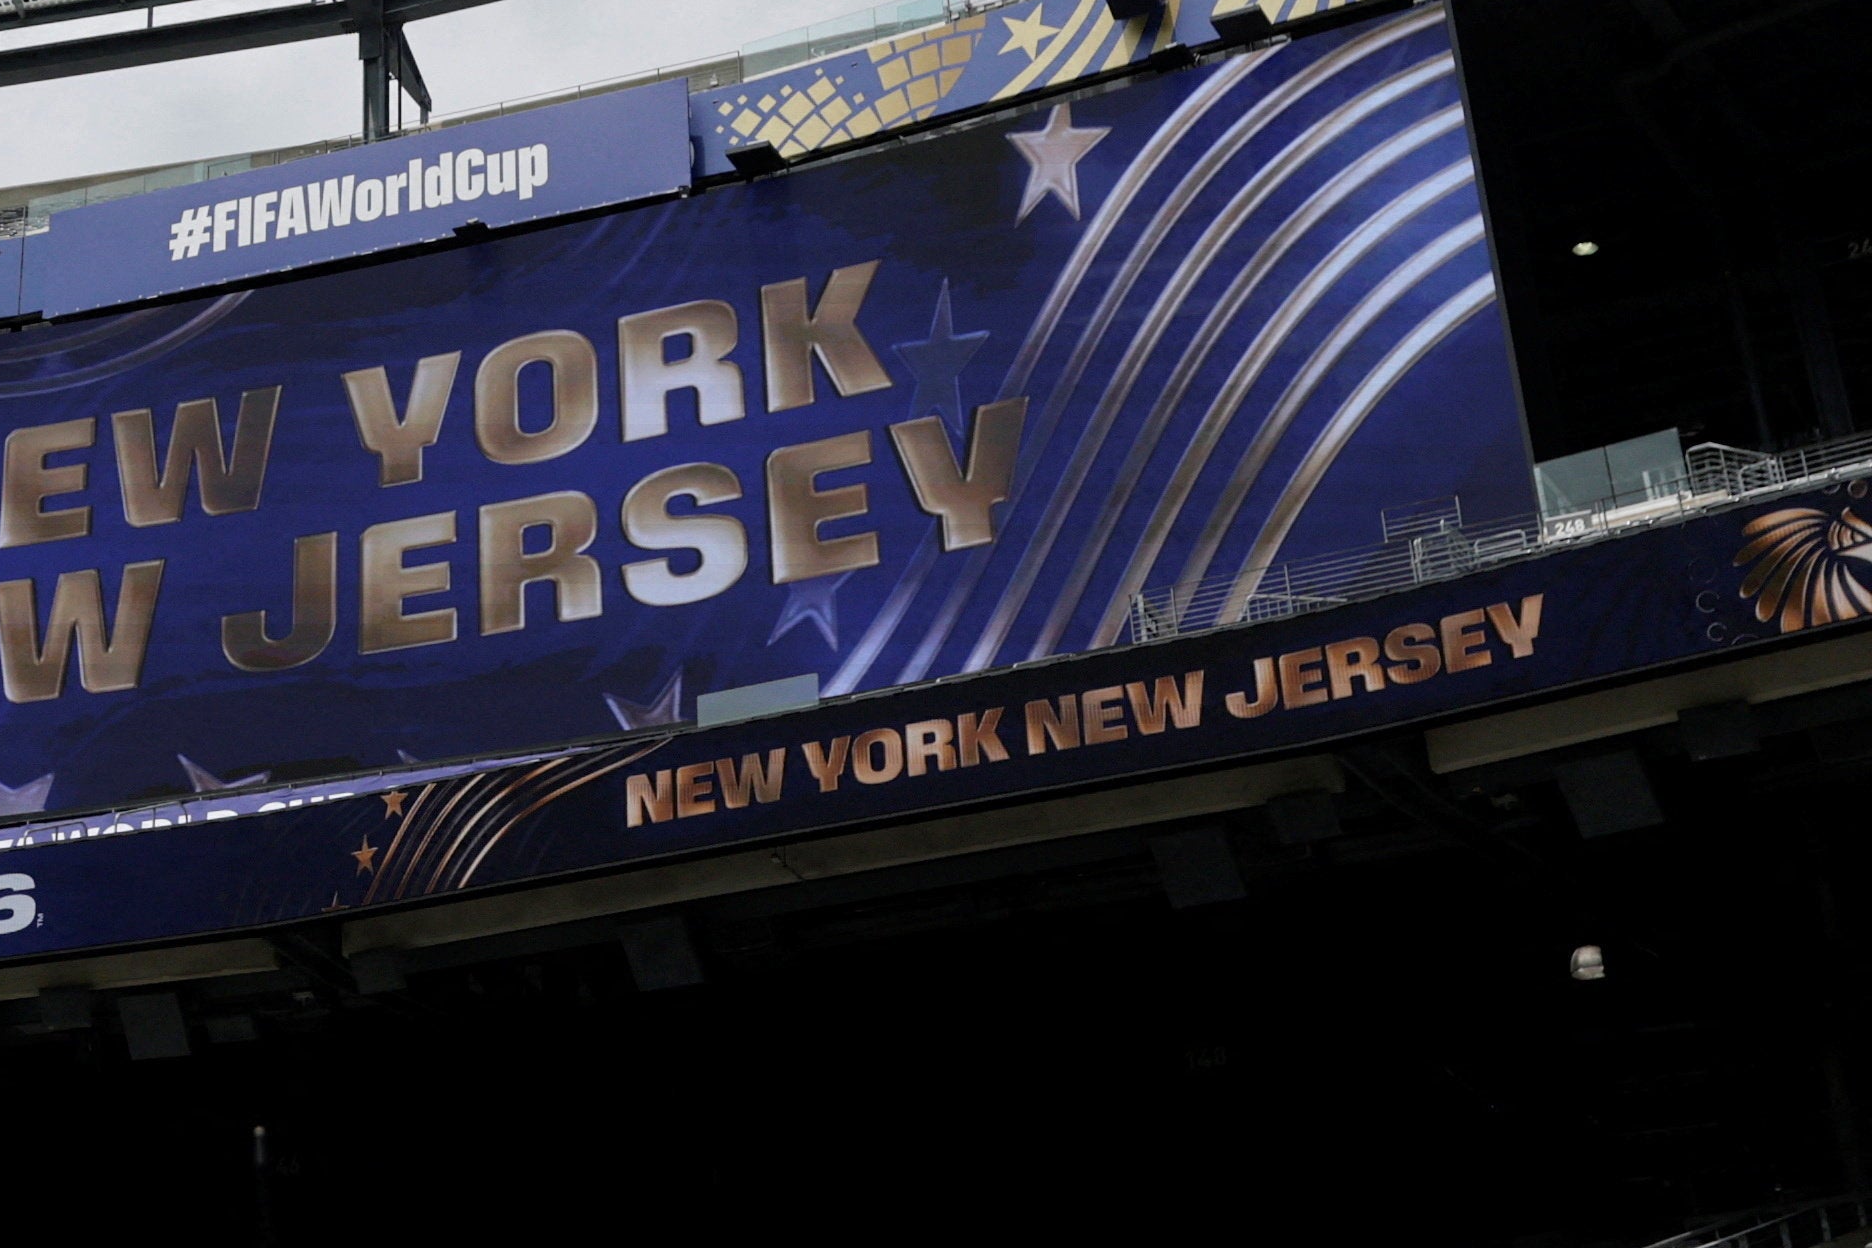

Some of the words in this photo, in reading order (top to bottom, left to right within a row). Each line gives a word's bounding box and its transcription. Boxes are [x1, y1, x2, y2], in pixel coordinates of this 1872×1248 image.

[168, 143, 549, 261] #FIFAWorldCup
[341, 259, 892, 487] YORK
[221, 396, 1029, 673] JERSEY
[1554, 518, 1585, 537] 248
[626, 747, 786, 828] NEW
[802, 707, 1009, 792] YORK
[1025, 670, 1204, 755] NEW
[1225, 593, 1544, 718] JERSEY
